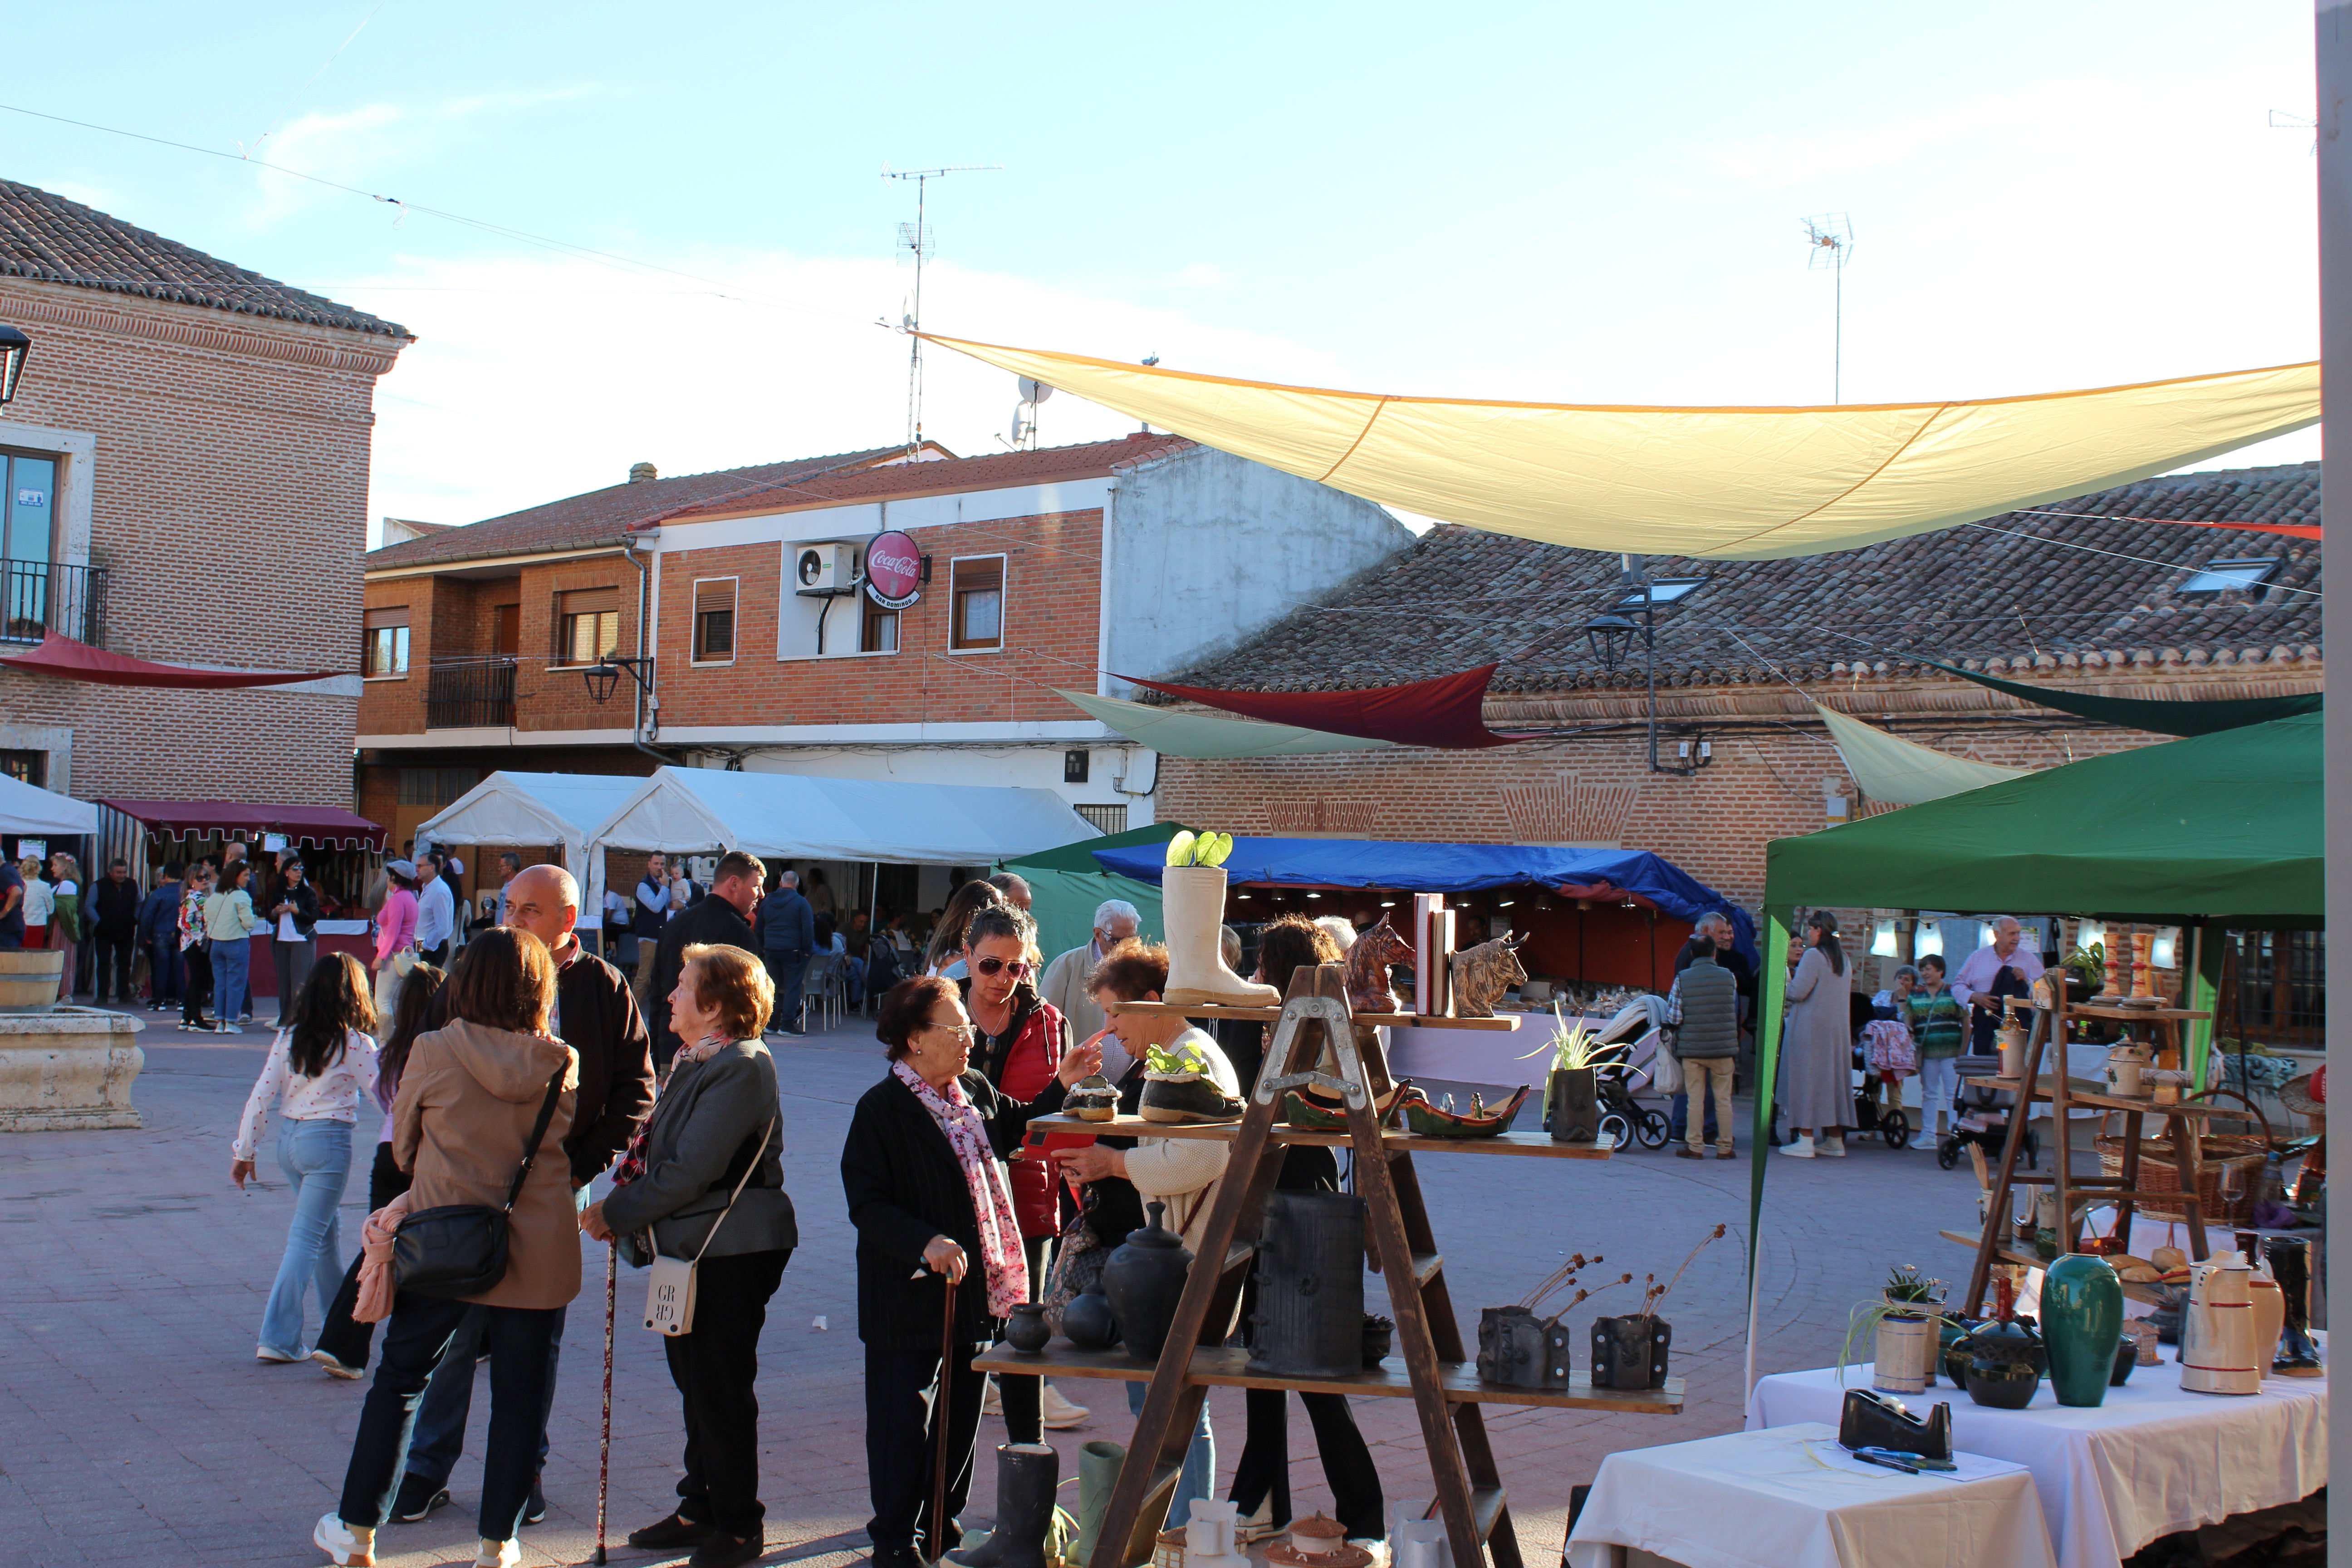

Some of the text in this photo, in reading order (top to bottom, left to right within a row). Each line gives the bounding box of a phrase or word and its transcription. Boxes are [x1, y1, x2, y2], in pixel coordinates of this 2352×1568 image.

[871, 550, 919, 577] Coca-Cola
[875, 594, 912, 608] BAR DOMINGO
[658, 1284, 675, 1303] GR
